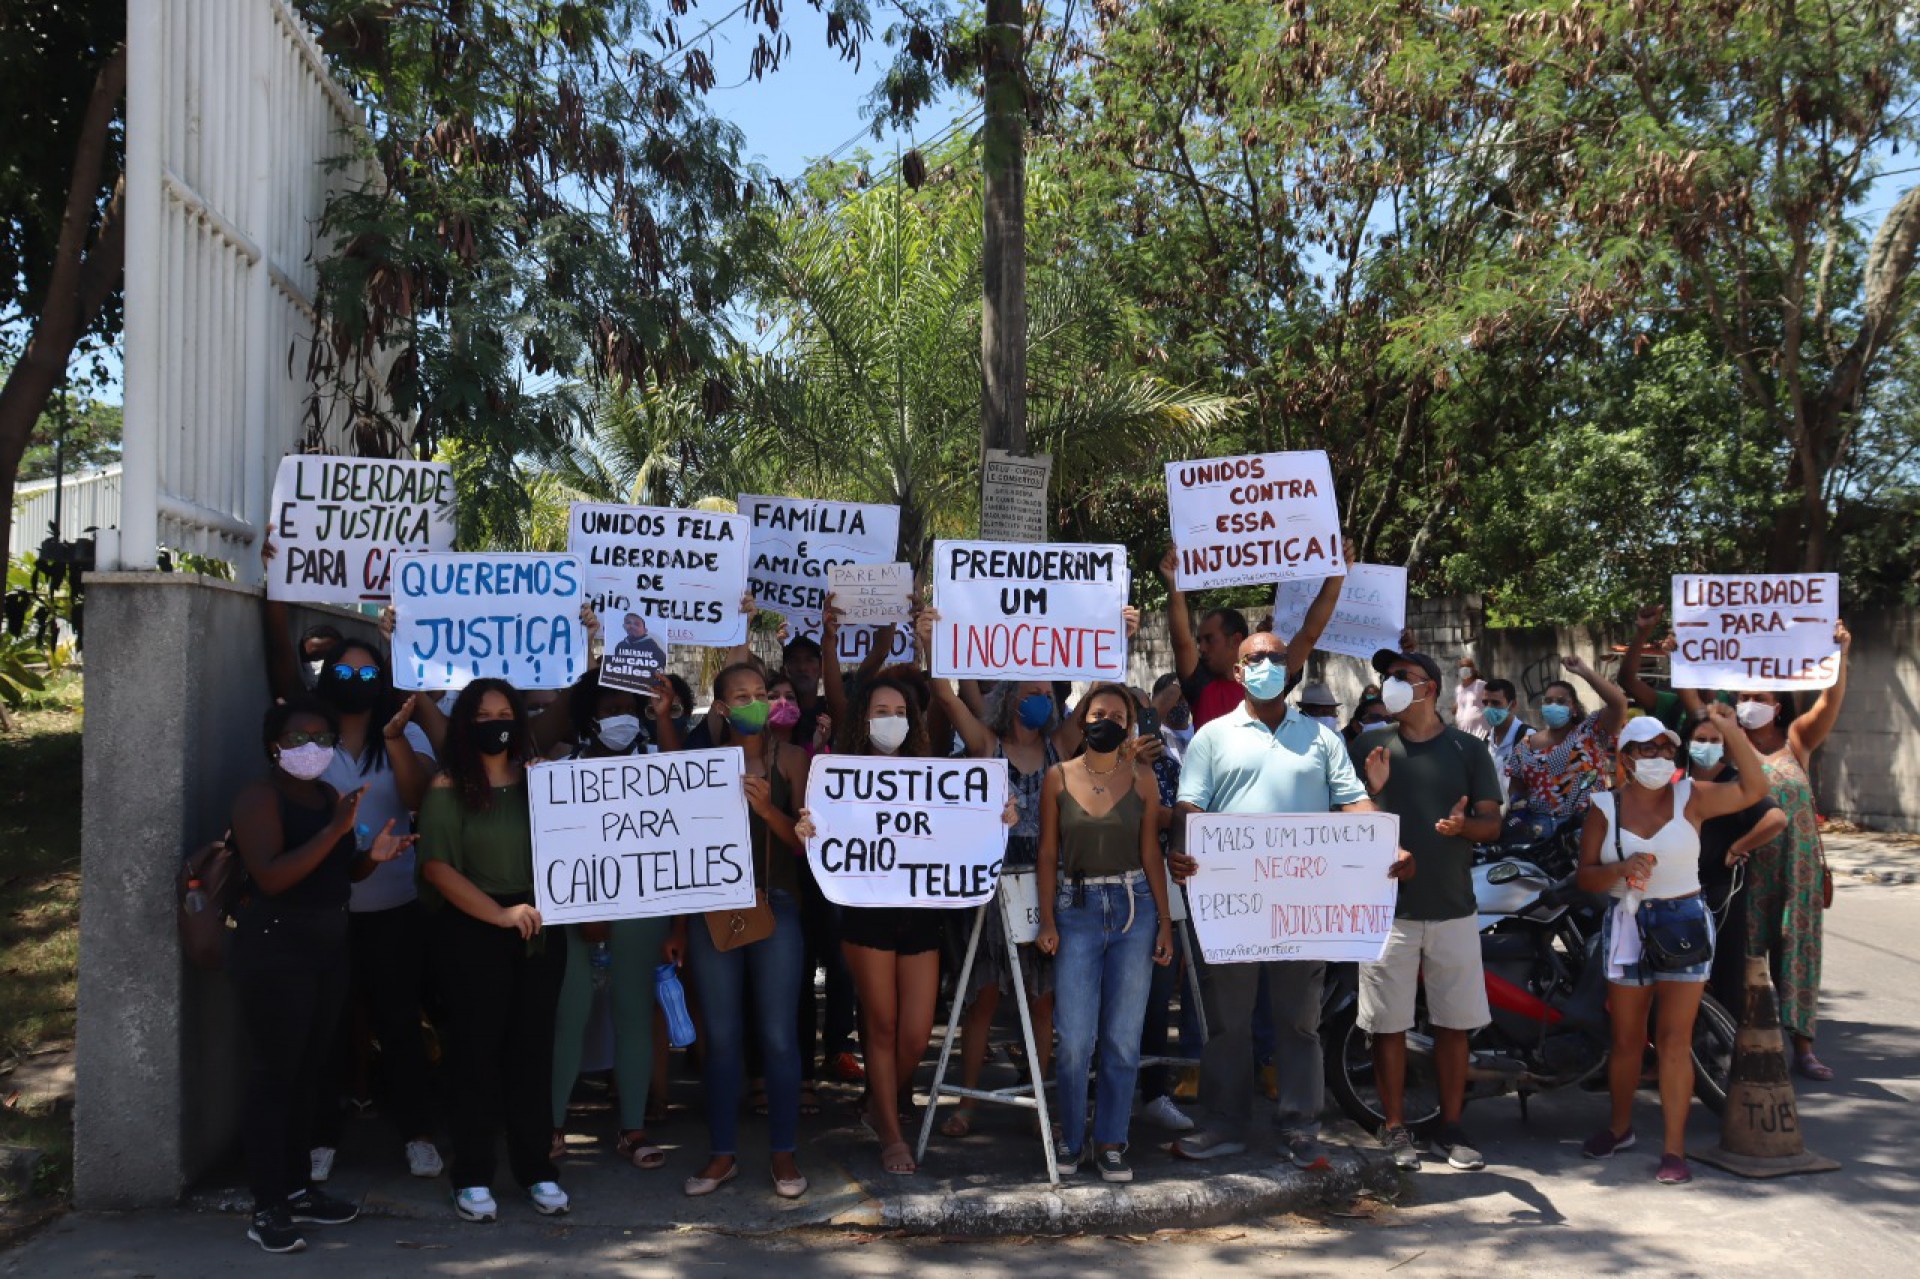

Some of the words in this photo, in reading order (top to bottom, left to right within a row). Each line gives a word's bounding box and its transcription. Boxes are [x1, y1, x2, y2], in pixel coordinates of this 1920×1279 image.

[296, 462, 450, 504] LIBERDADE
[1180, 458, 1265, 488] UNIDOS
[1230, 480, 1318, 505] CONTRA
[280, 502, 299, 539] E
[316, 505, 430, 545] JUSTIÇA
[581, 511, 665, 537] UNIDOS
[753, 503, 866, 535] FAMÍLIA
[1216, 514, 1276, 534] ESSA
[590, 545, 720, 572] LIBERDADE
[797, 540, 808, 558] E
[286, 547, 348, 588] PARA
[401, 560, 577, 597] QUEREMOS
[951, 547, 1114, 582] PRENDERAM
[637, 573, 664, 592] DE
[1683, 578, 1826, 607] LIBERDADE
[639, 596, 723, 623] TELLES
[999, 587, 1048, 616] UM
[1720, 611, 1786, 635] PARA
[412, 613, 572, 664] JUSTIÇA
[951, 623, 1118, 669] INOCENTE
[1682, 638, 1741, 662] CAIO
[618, 648, 654, 659] LIBERDADE
[626, 657, 659, 668] CAIO
[1740, 656, 1835, 680] TELLES
[605, 662, 652, 678] telles
[549, 758, 728, 805] LIBERDADE
[824, 766, 990, 804] JUSTIÇA
[602, 807, 681, 842] PARA
[875, 811, 933, 836] POR
[1200, 824, 1256, 854] MAIS
[1265, 826, 1298, 848] UM
[1302, 823, 1376, 847] JOVEM
[820, 837, 896, 873] CAIO
[1253, 855, 1329, 882] NEGRO
[546, 856, 622, 907] CAIO
[621, 843, 744, 898] TELLES
[898, 859, 1002, 898] TELLES
[1200, 893, 1264, 922] PRESO
[1270, 903, 1394, 940] INJUSTAMENTE
